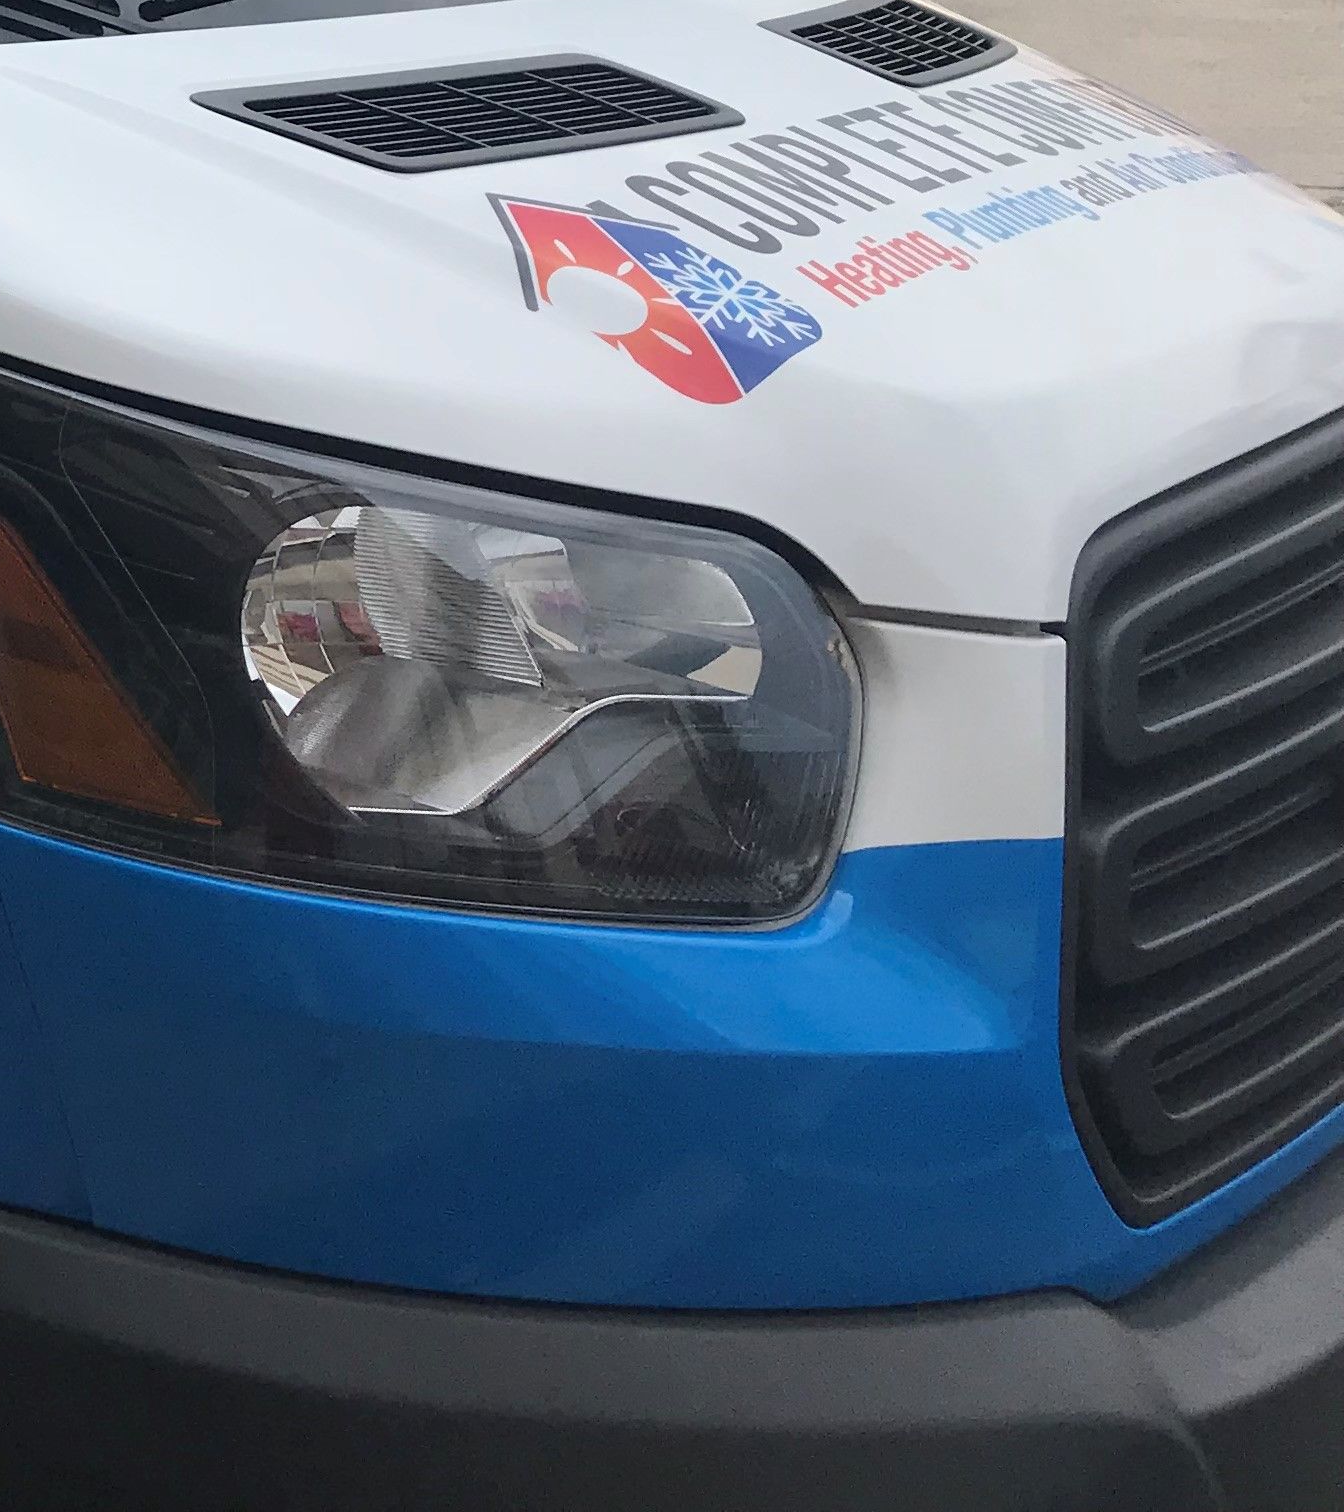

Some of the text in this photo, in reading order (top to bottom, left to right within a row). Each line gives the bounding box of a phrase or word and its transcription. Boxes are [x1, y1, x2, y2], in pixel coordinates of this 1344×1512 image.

[625, 100, 1028, 255] COMPLETE
[1059, 163, 1137, 208] and
[1095, 157, 1169, 193] Air
[921, 185, 1102, 250] Plumbing
[795, 229, 979, 308] Heating,
